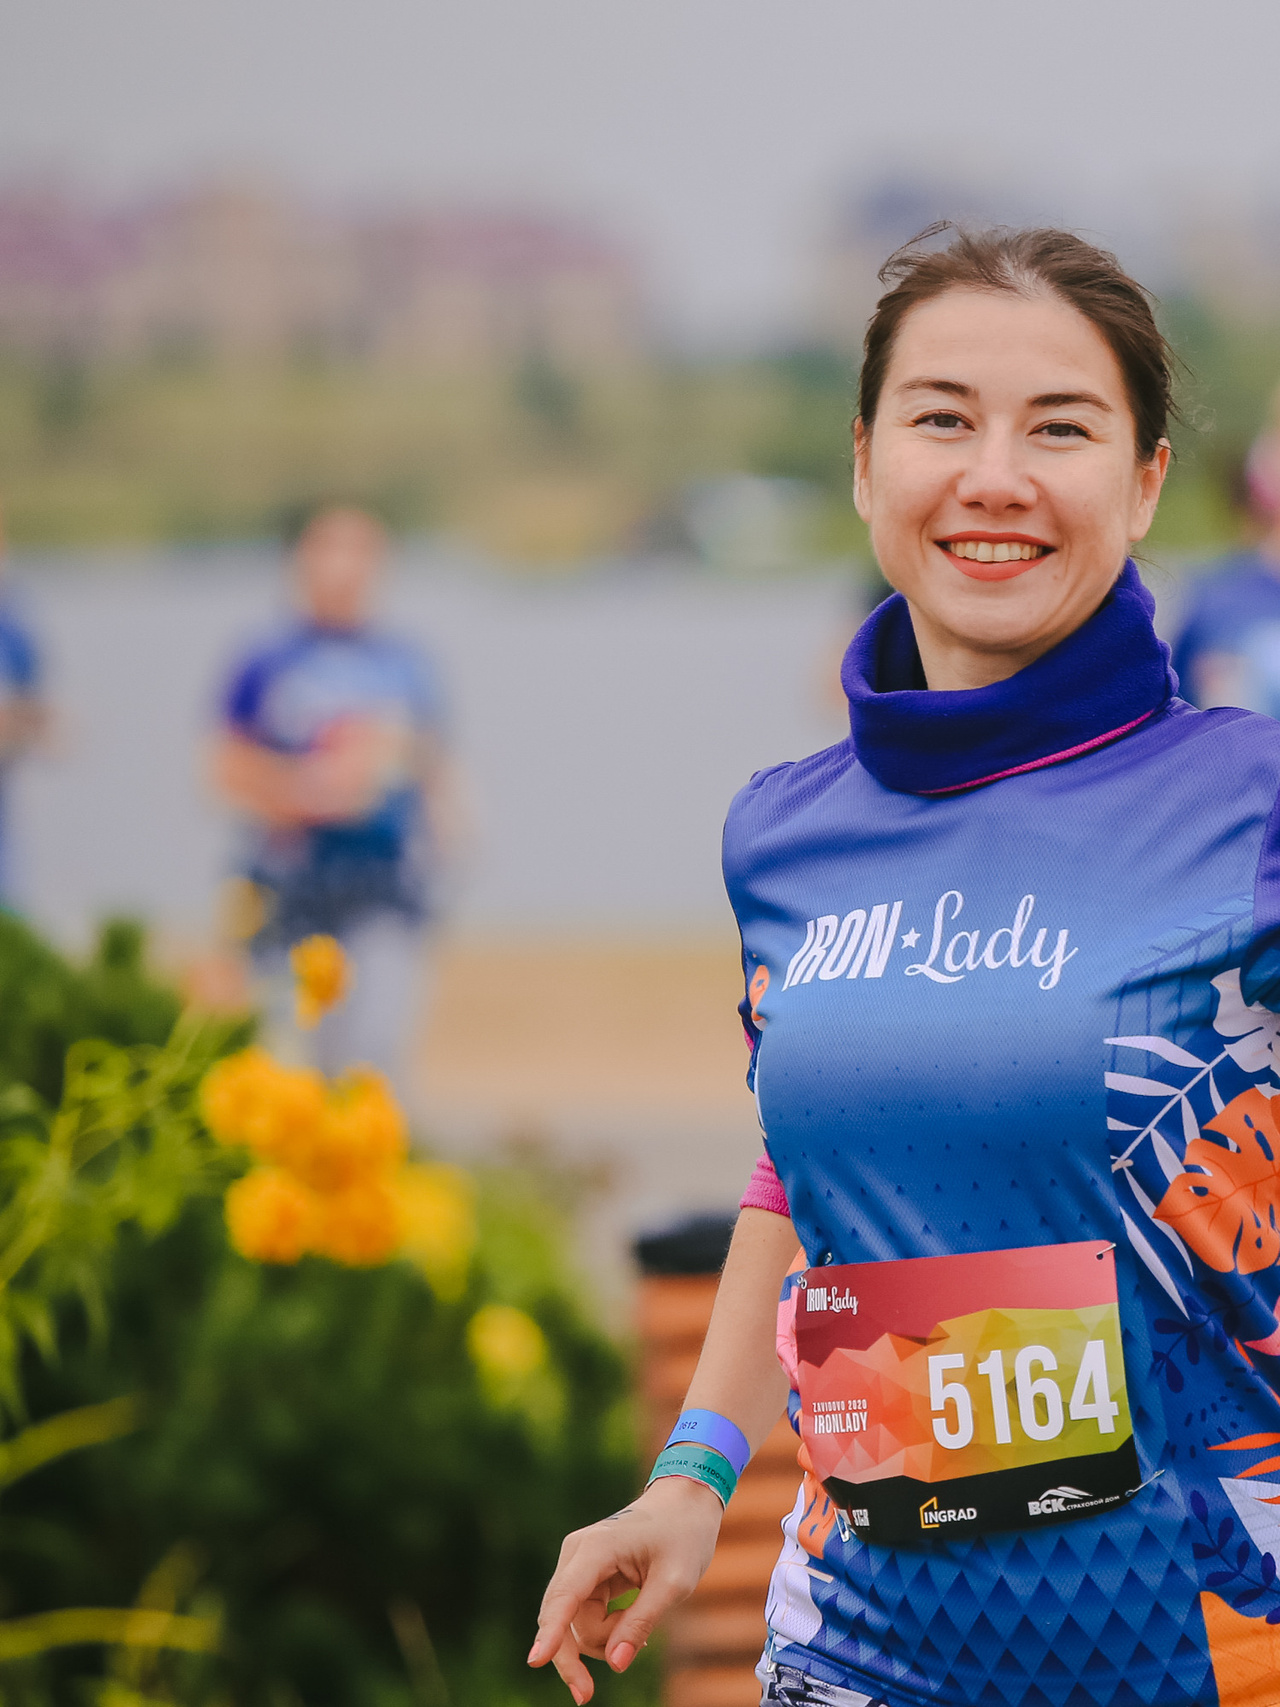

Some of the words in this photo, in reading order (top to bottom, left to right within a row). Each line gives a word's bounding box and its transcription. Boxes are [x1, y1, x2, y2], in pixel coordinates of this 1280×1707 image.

[781, 900, 903, 992] IRON
[904, 889, 1079, 991] Lady
[806, 1287, 828, 1312] IRON
[829, 1286, 859, 1316] Lady
[812, 1400, 846, 1413] ZAVIDOVO
[847, 1398, 868, 1411] 2020
[927, 1339, 1120, 1450] 5164
[814, 1411, 868, 1435] IRONLADY
[923, 1507, 978, 1525] INGRAD
[1027, 1498, 1067, 1516] ВСК
